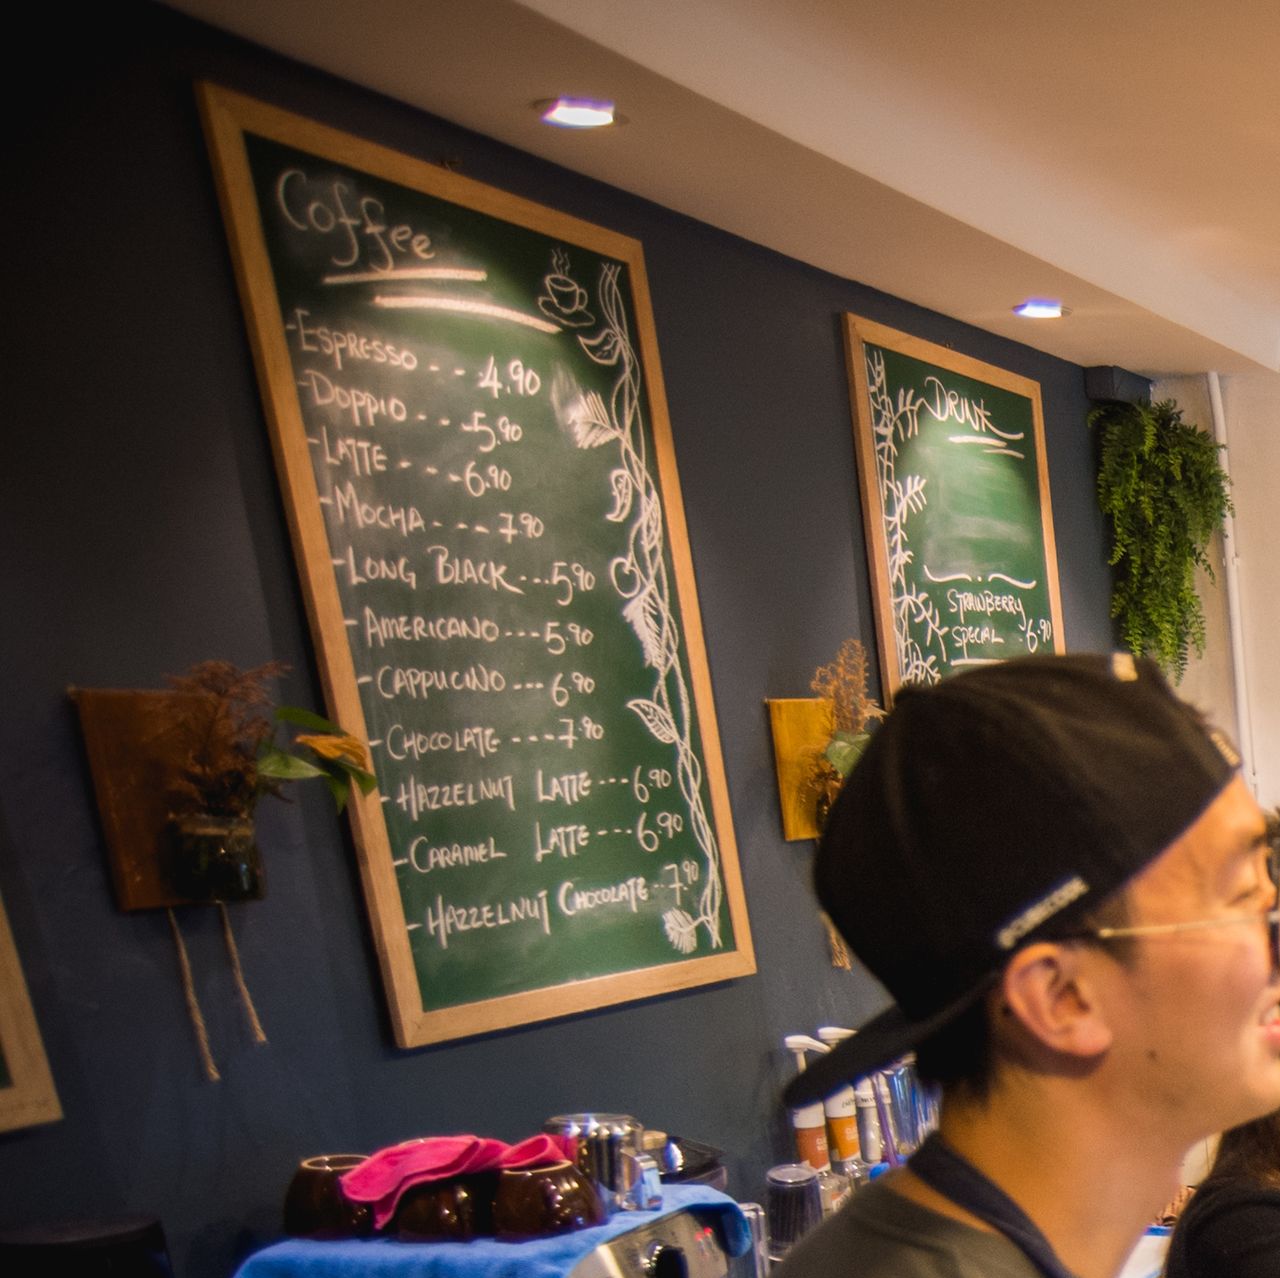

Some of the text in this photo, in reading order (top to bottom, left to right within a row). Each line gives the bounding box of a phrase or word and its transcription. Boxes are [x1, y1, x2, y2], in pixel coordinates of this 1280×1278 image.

[278, 170, 436, 273] Coffee
[477, 355, 541, 399] 4.90
[463, 461, 513, 497] 6.90
[335, 482, 545, 543] MOCHA 7.90
[348, 554, 416, 590] LONG
[427, 546, 525, 595] BLACK
[364, 607, 499, 648] AMERICANO
[377, 663, 506, 700] CAPPUCINO
